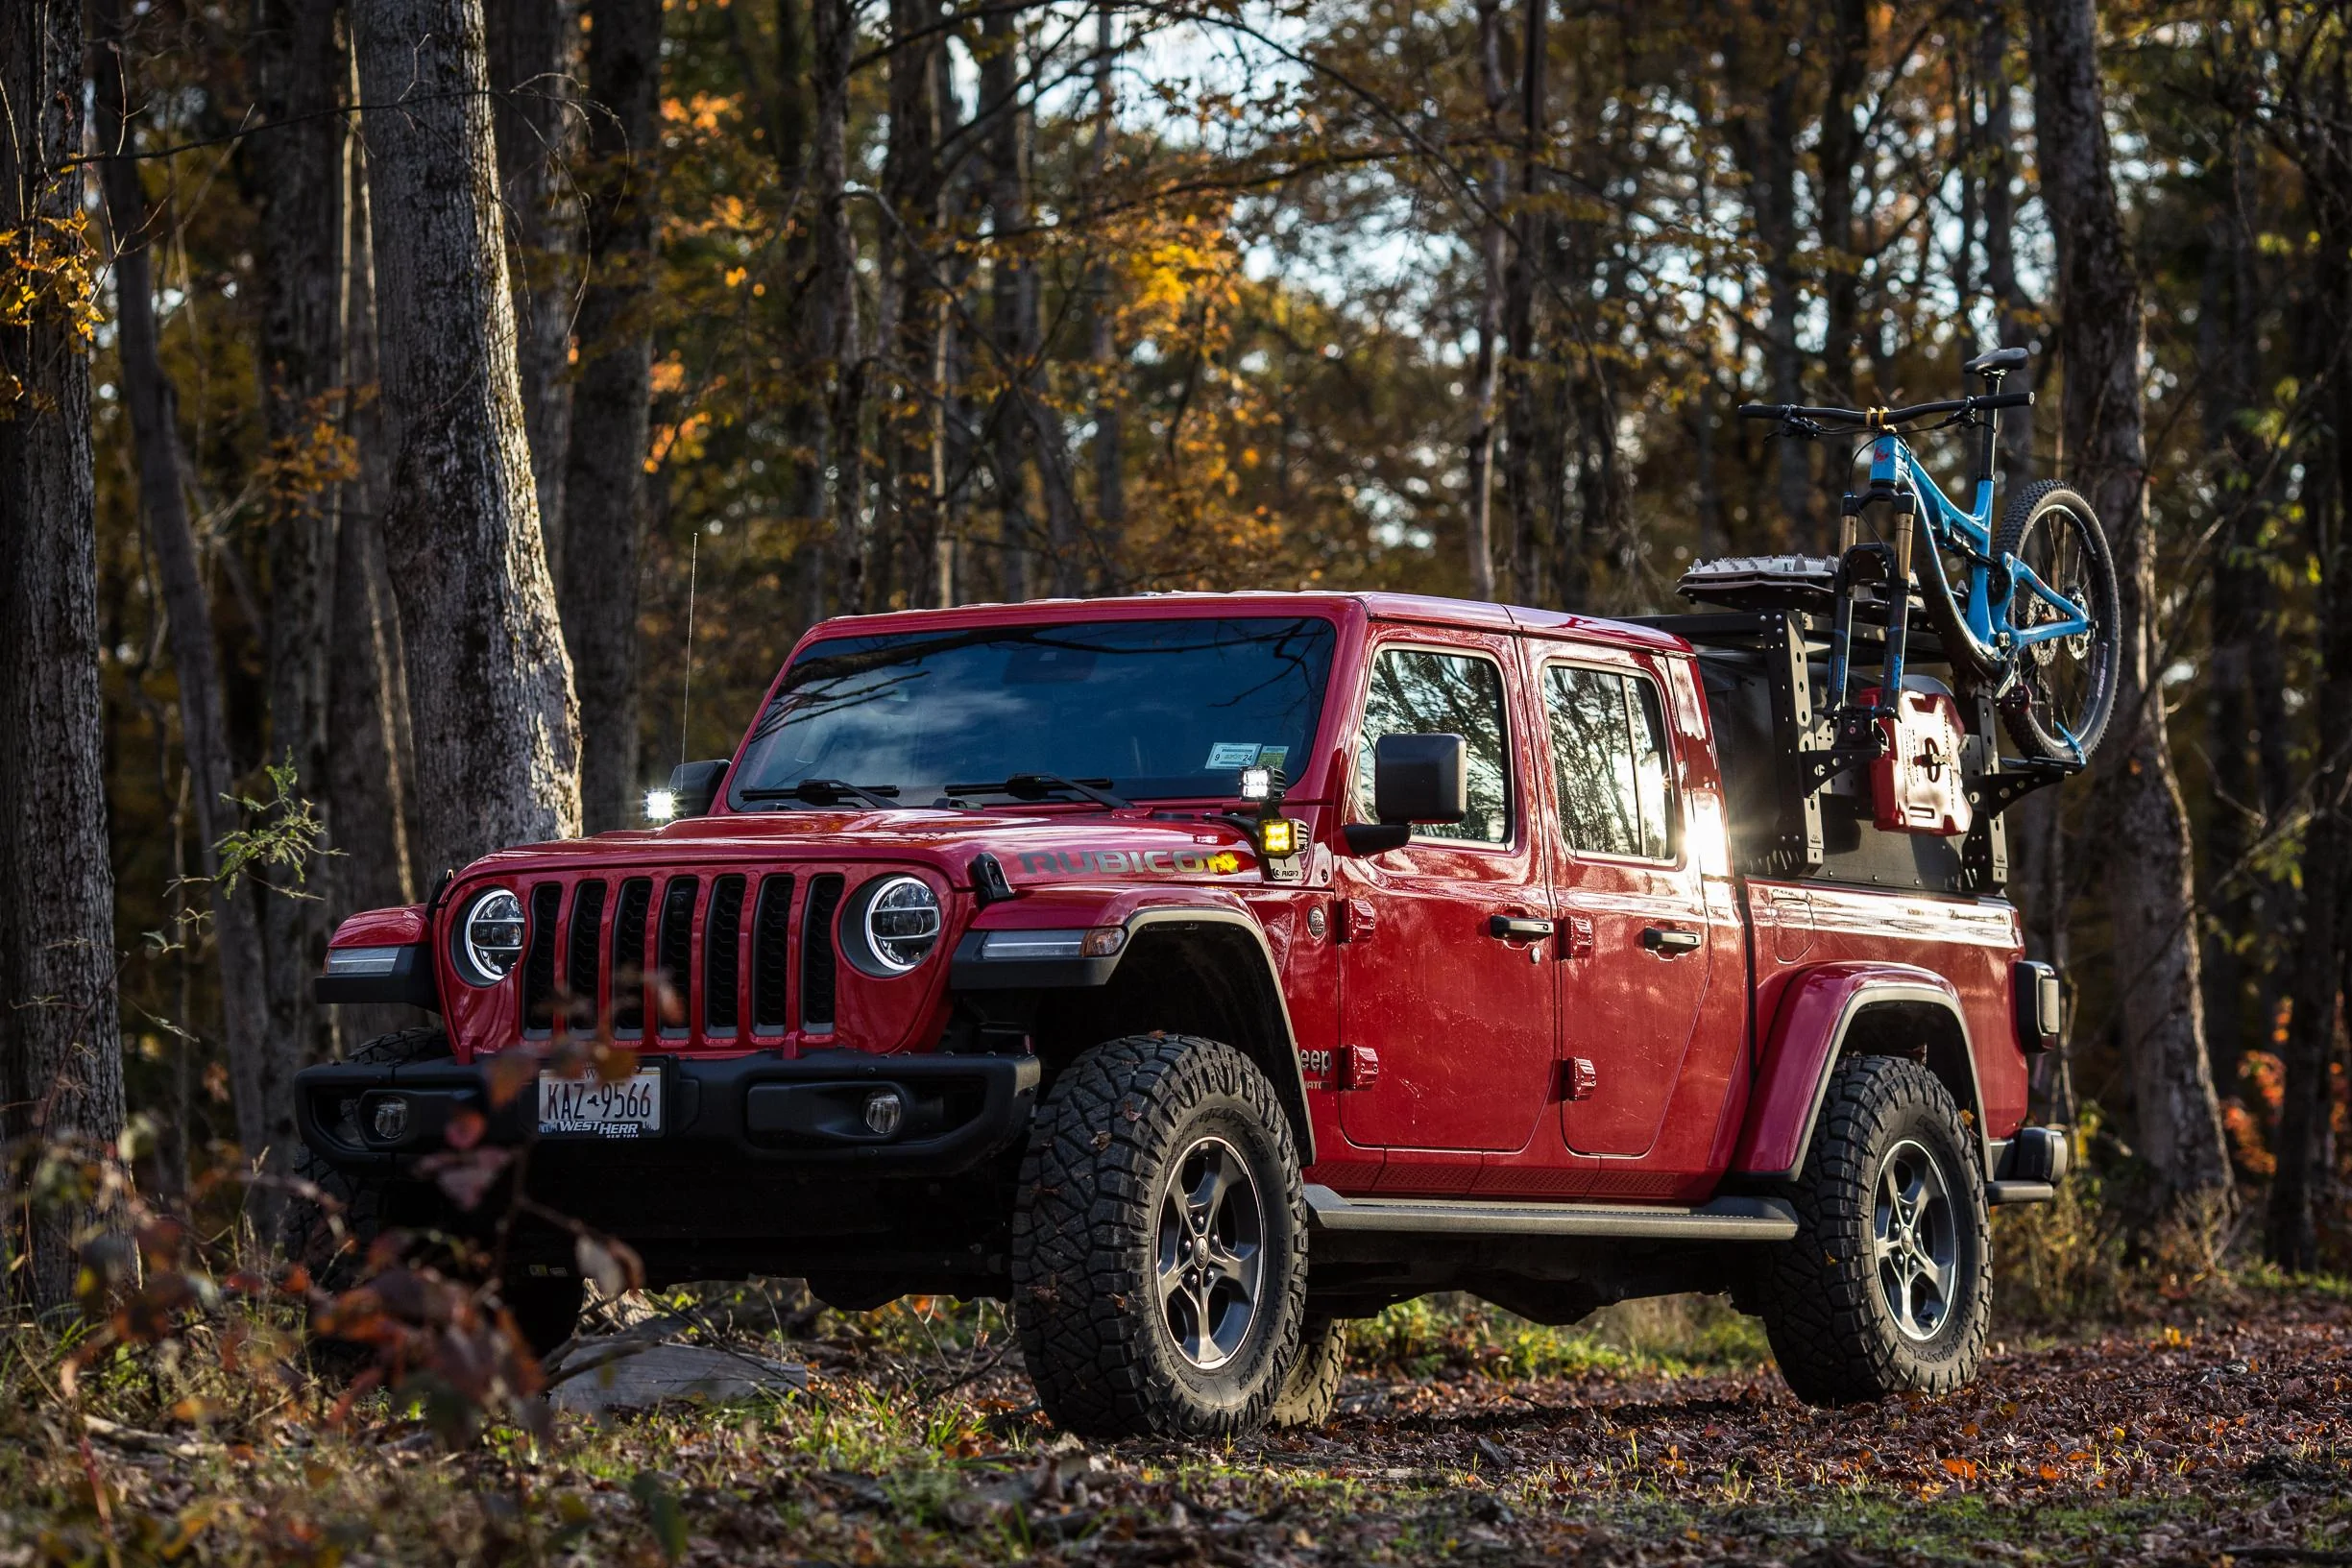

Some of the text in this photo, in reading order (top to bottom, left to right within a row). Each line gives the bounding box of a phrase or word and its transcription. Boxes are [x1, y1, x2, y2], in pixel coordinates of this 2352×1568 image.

[1019, 850, 1239, 874] RUBICON
[1297, 1047, 1332, 1076] eep
[547, 1083, 651, 1119] KAZ 9566
